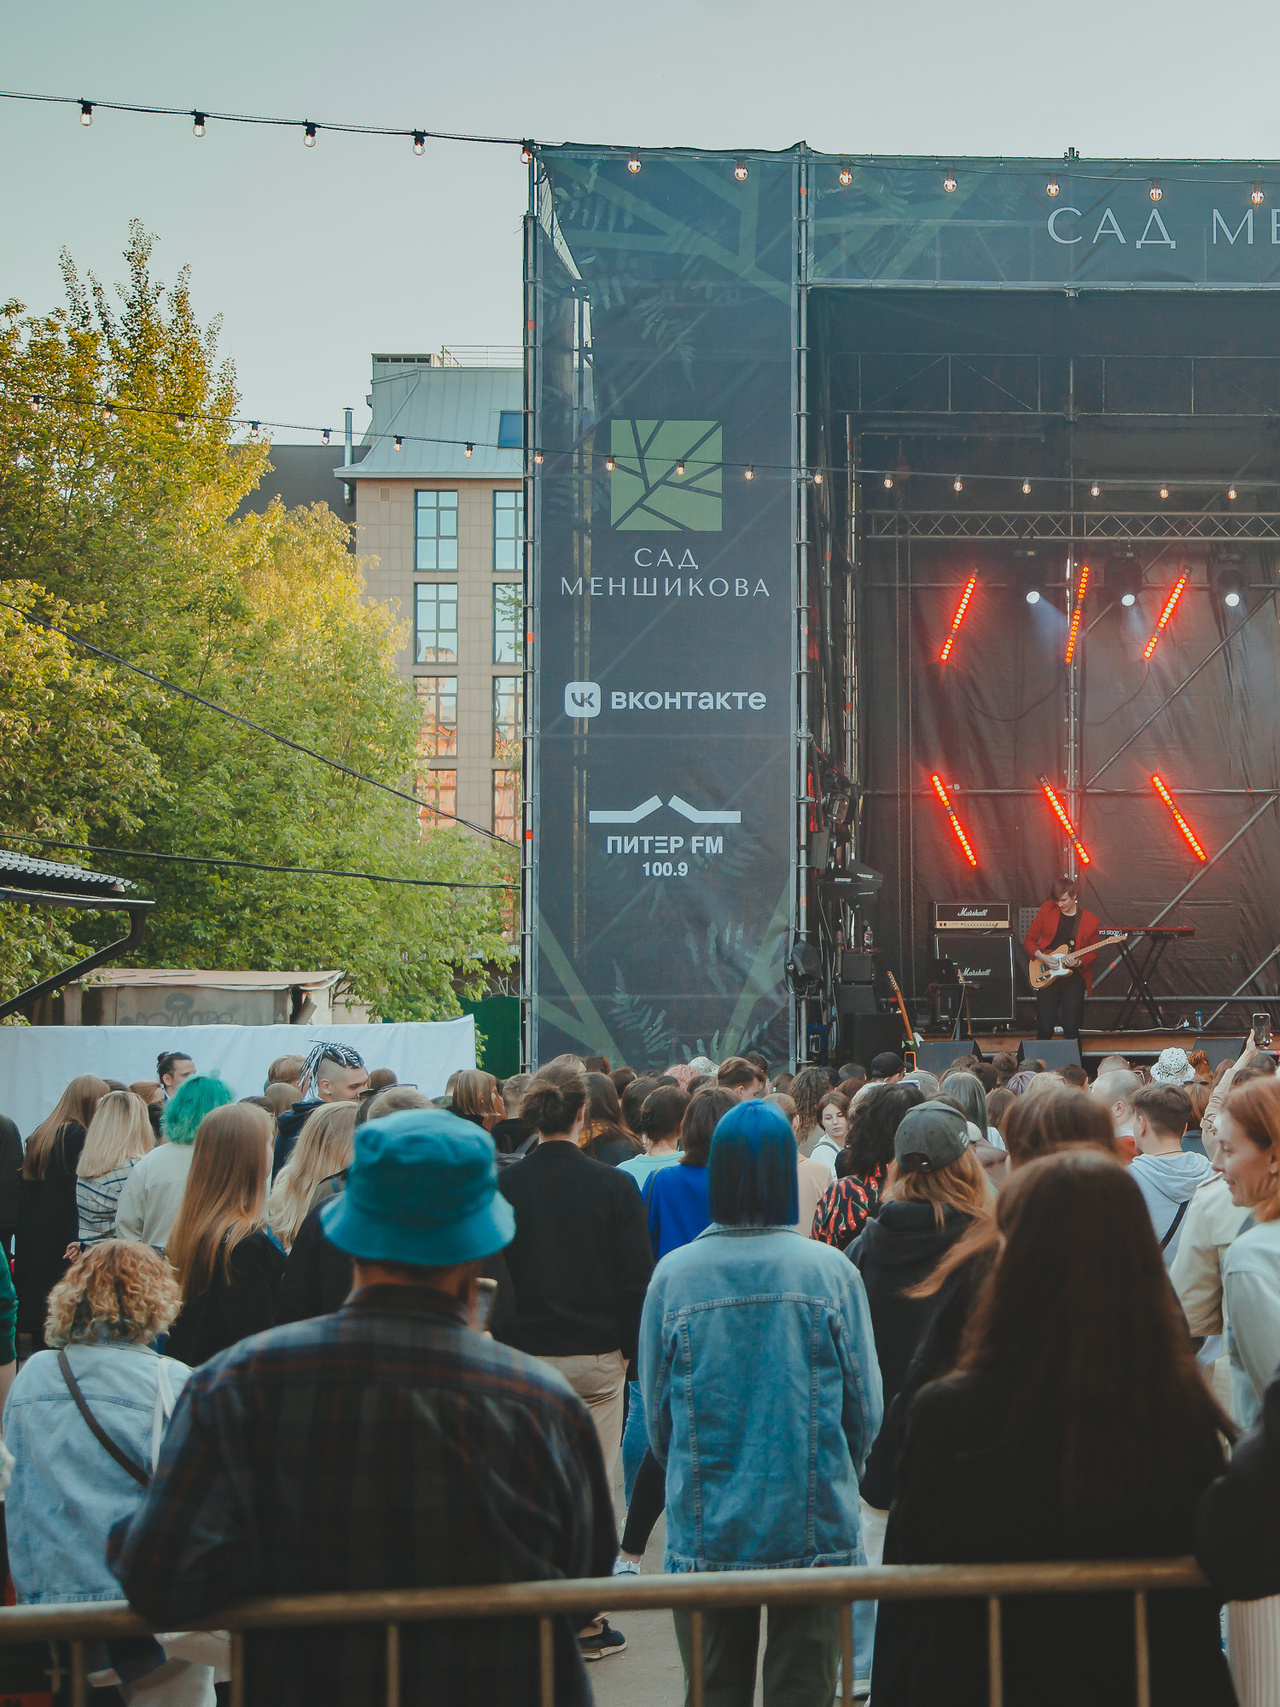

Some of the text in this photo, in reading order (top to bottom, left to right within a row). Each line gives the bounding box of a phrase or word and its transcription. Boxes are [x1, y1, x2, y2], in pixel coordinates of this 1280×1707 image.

[1047, 206, 1176, 249] САД
[634, 547, 699, 570] САД
[561, 576, 770, 598] МЕНШИКОВА
[607, 835, 724, 854] ПИТЕР FM
[642, 861, 689, 877] 100.9
[957, 907, 988, 917] Marshall
[960, 967, 991, 977] Marshall
